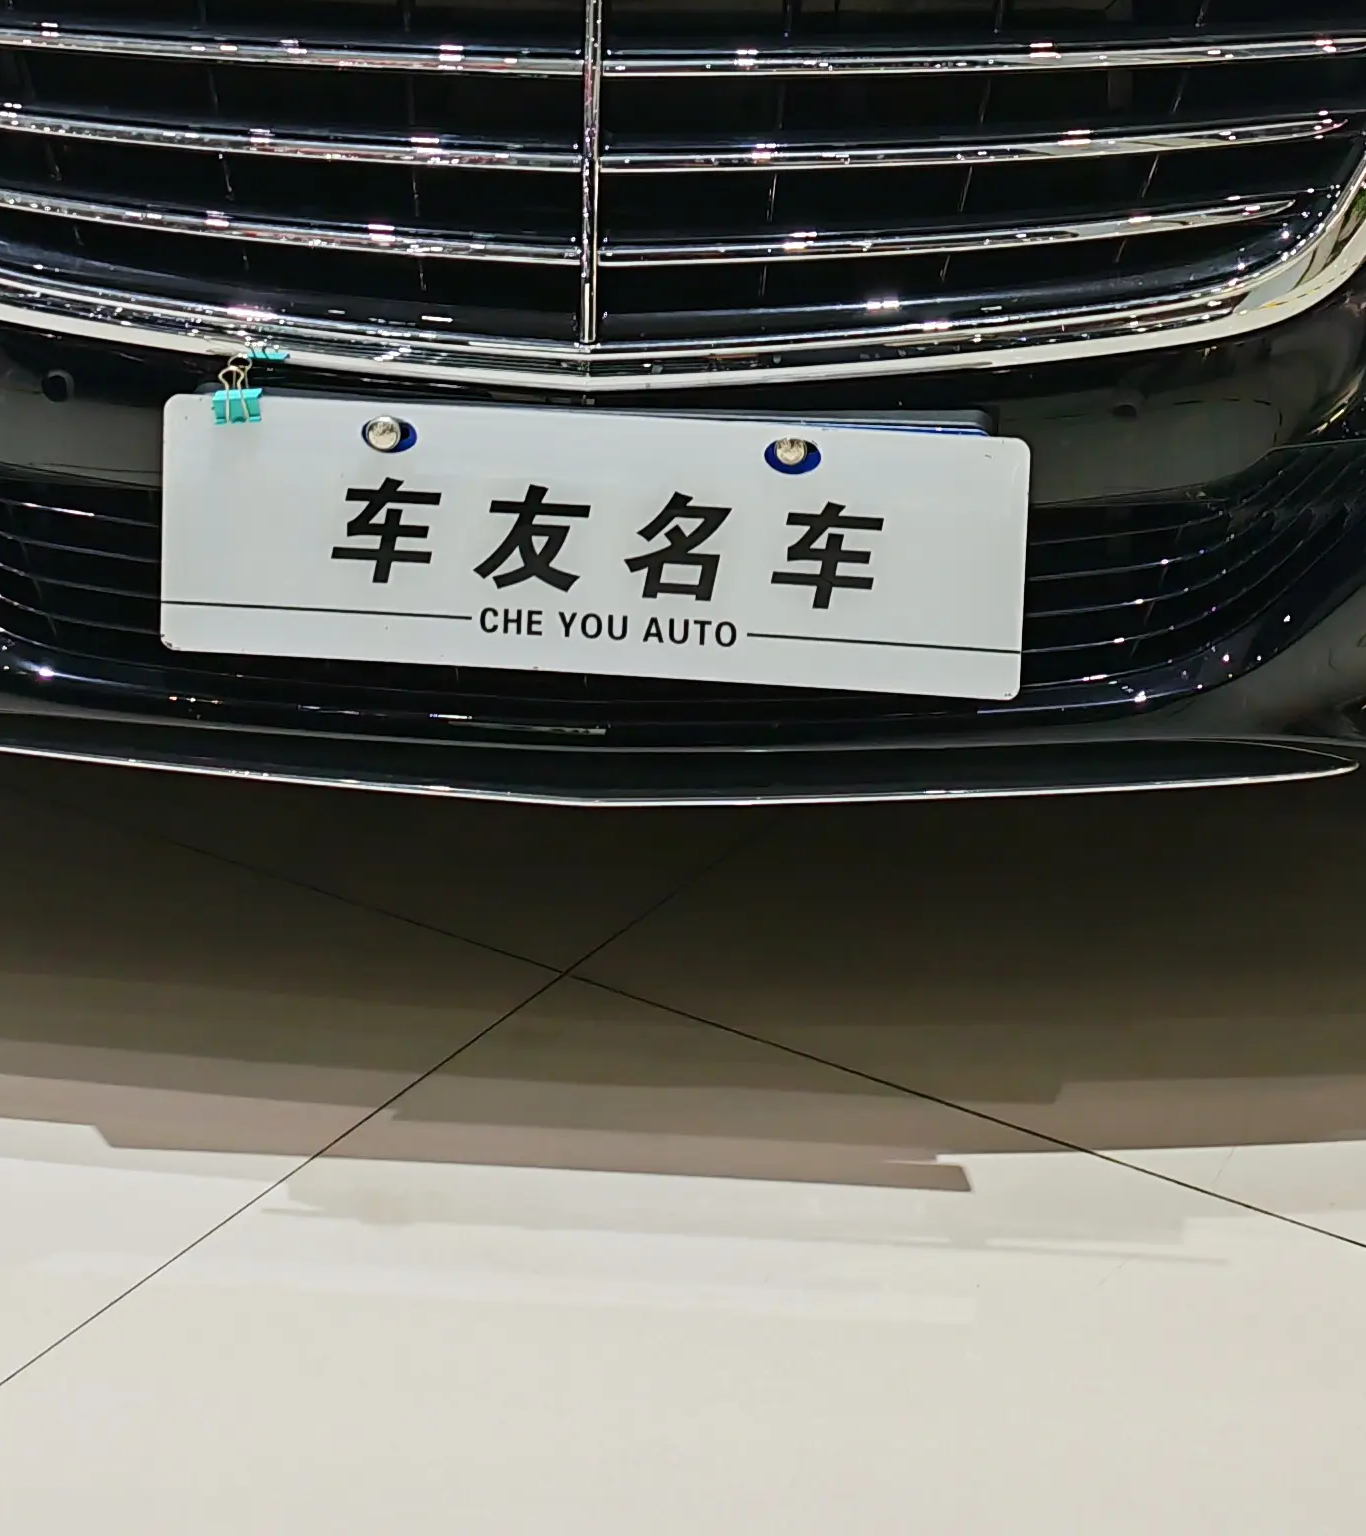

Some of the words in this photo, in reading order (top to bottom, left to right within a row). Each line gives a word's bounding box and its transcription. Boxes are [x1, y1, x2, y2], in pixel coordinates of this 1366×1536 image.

[331, 476, 884, 610] 车友名车
[479, 606, 543, 637] CHE
[558, 610, 630, 642] YOU
[642, 614, 738, 648] AUTO
